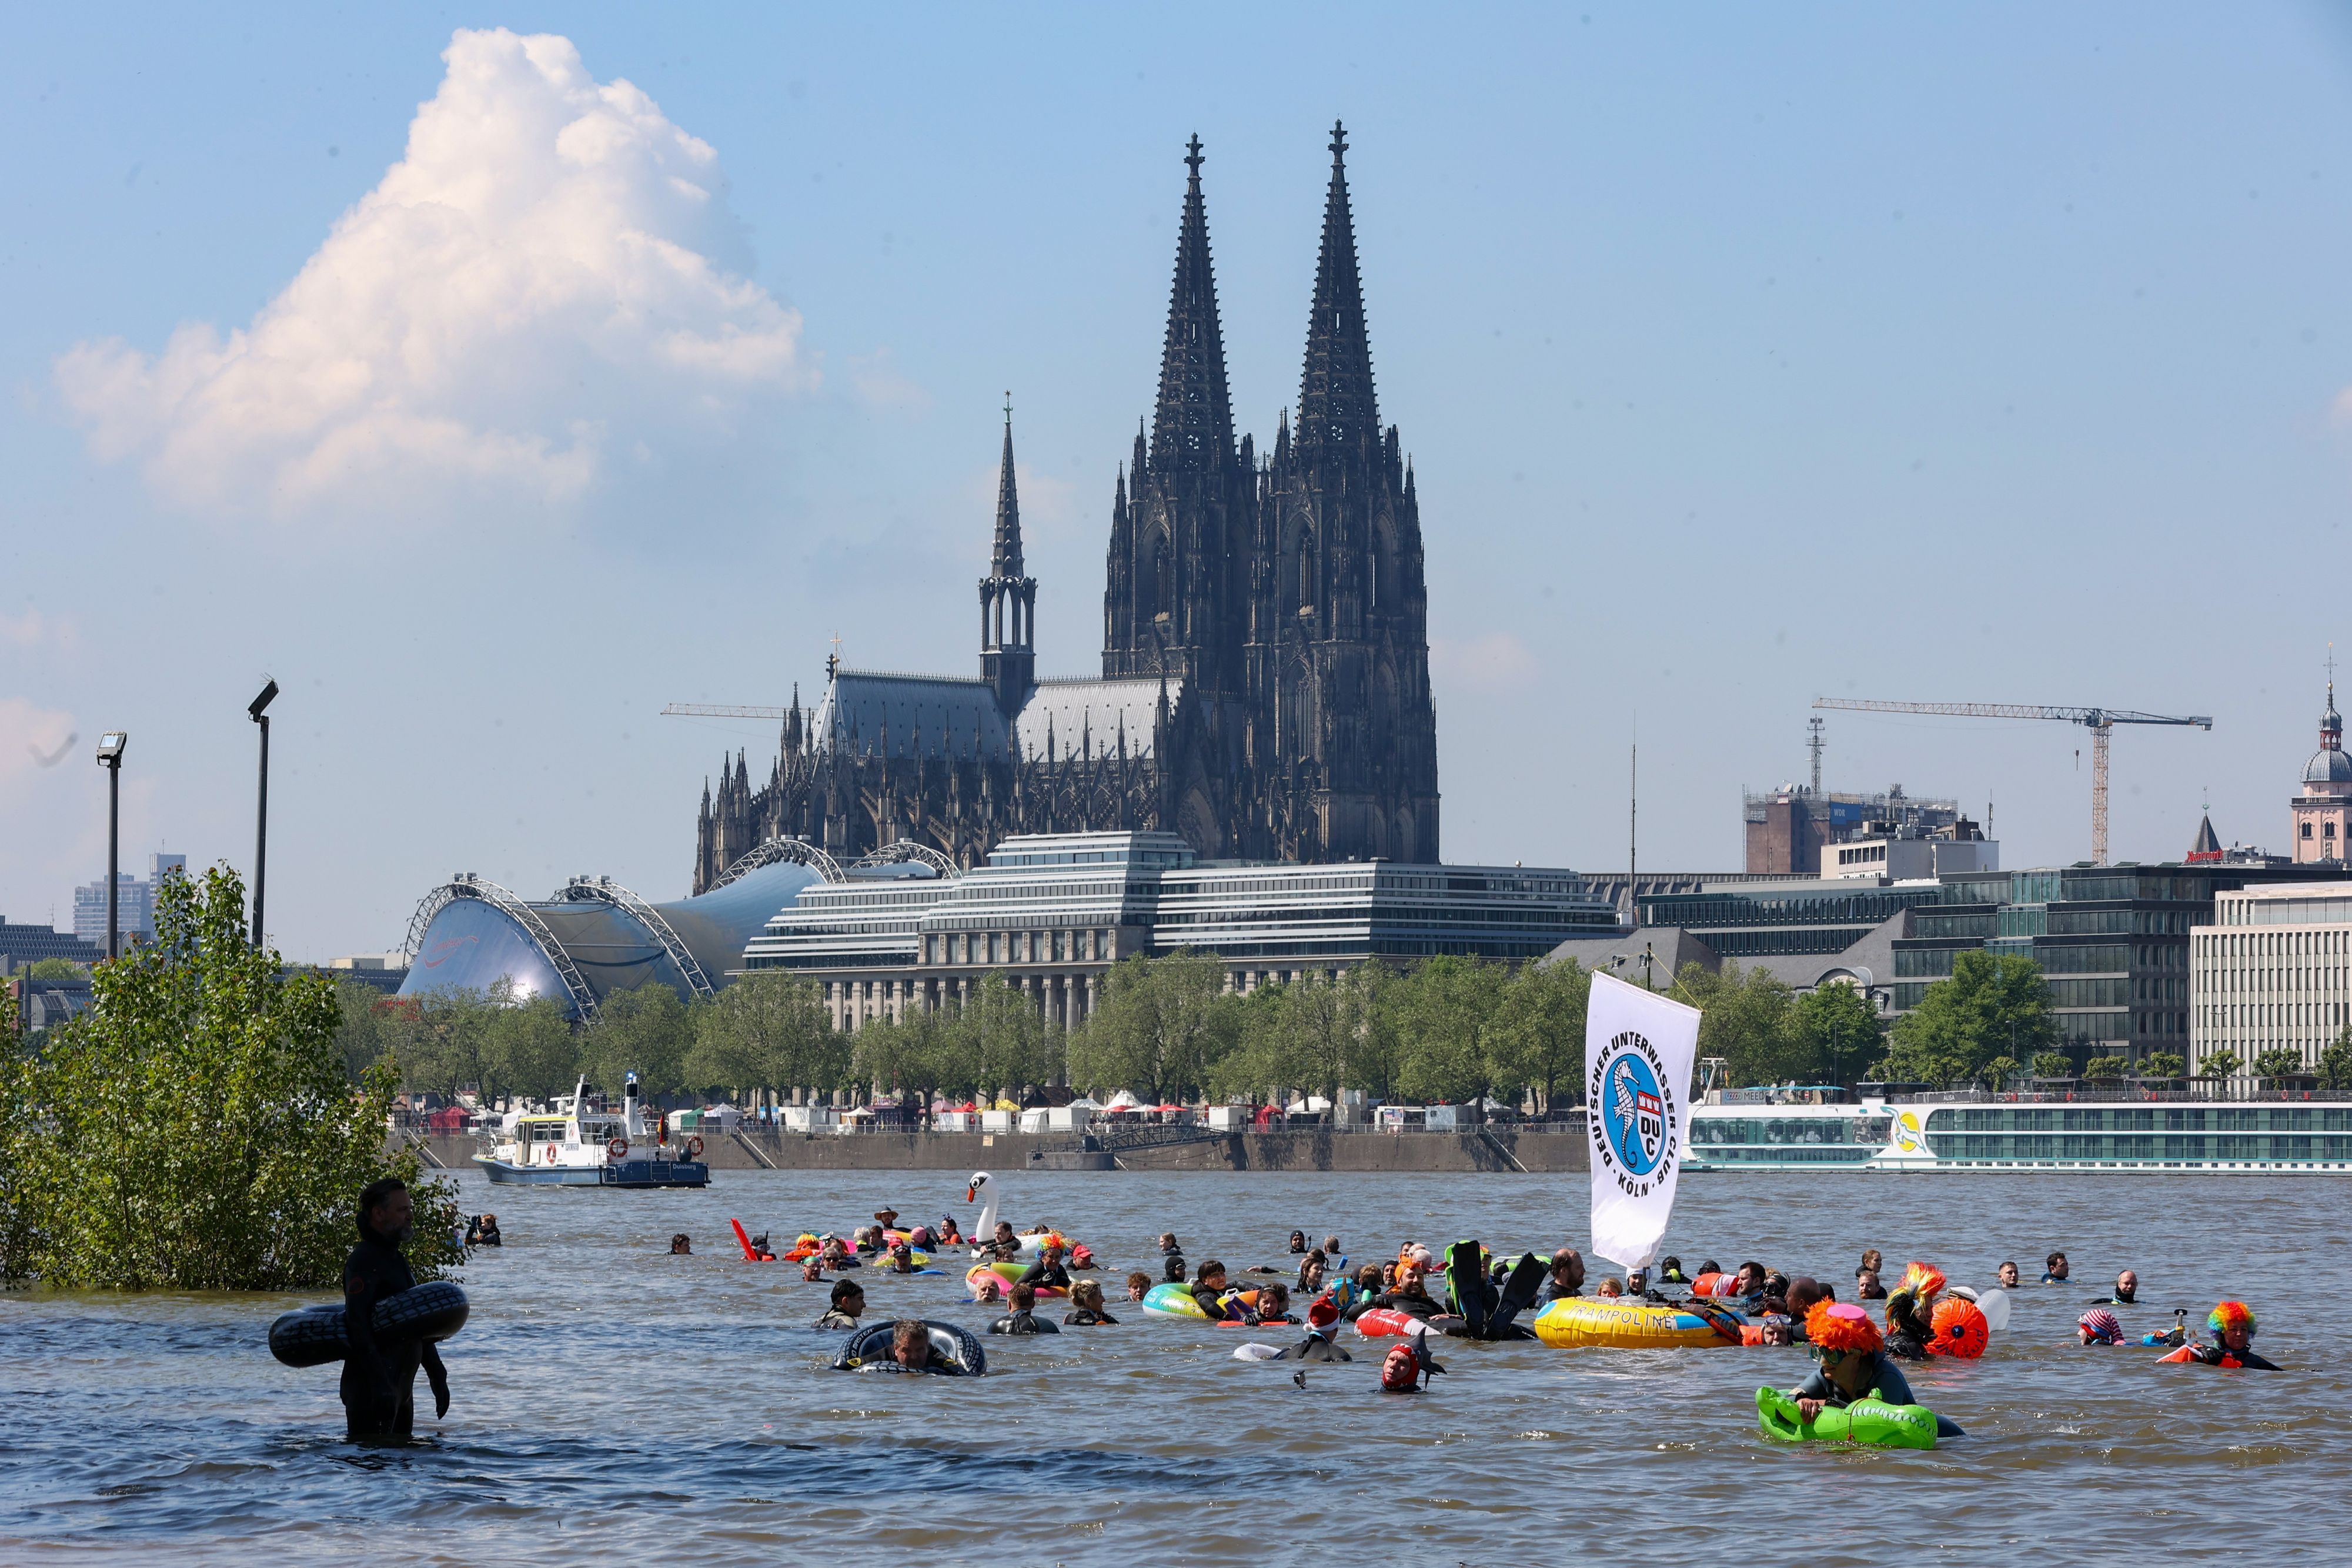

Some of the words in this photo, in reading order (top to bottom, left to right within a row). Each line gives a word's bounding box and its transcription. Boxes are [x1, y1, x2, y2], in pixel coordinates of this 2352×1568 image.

[1833, 808, 1845, 817] WDR
[1590, 1045, 1613, 1168] DEUTSCHER
[1611, 1031, 1676, 1129] UNTERWASSER
[1657, 1136, 1676, 1185] CLUB
[1641, 1116, 1661, 1138] DU
[1646, 1137, 1655, 1156] C
[1618, 1171, 1649, 1198] KÖLN
[1569, 1305, 1672, 1329] TRAMPOLINE
